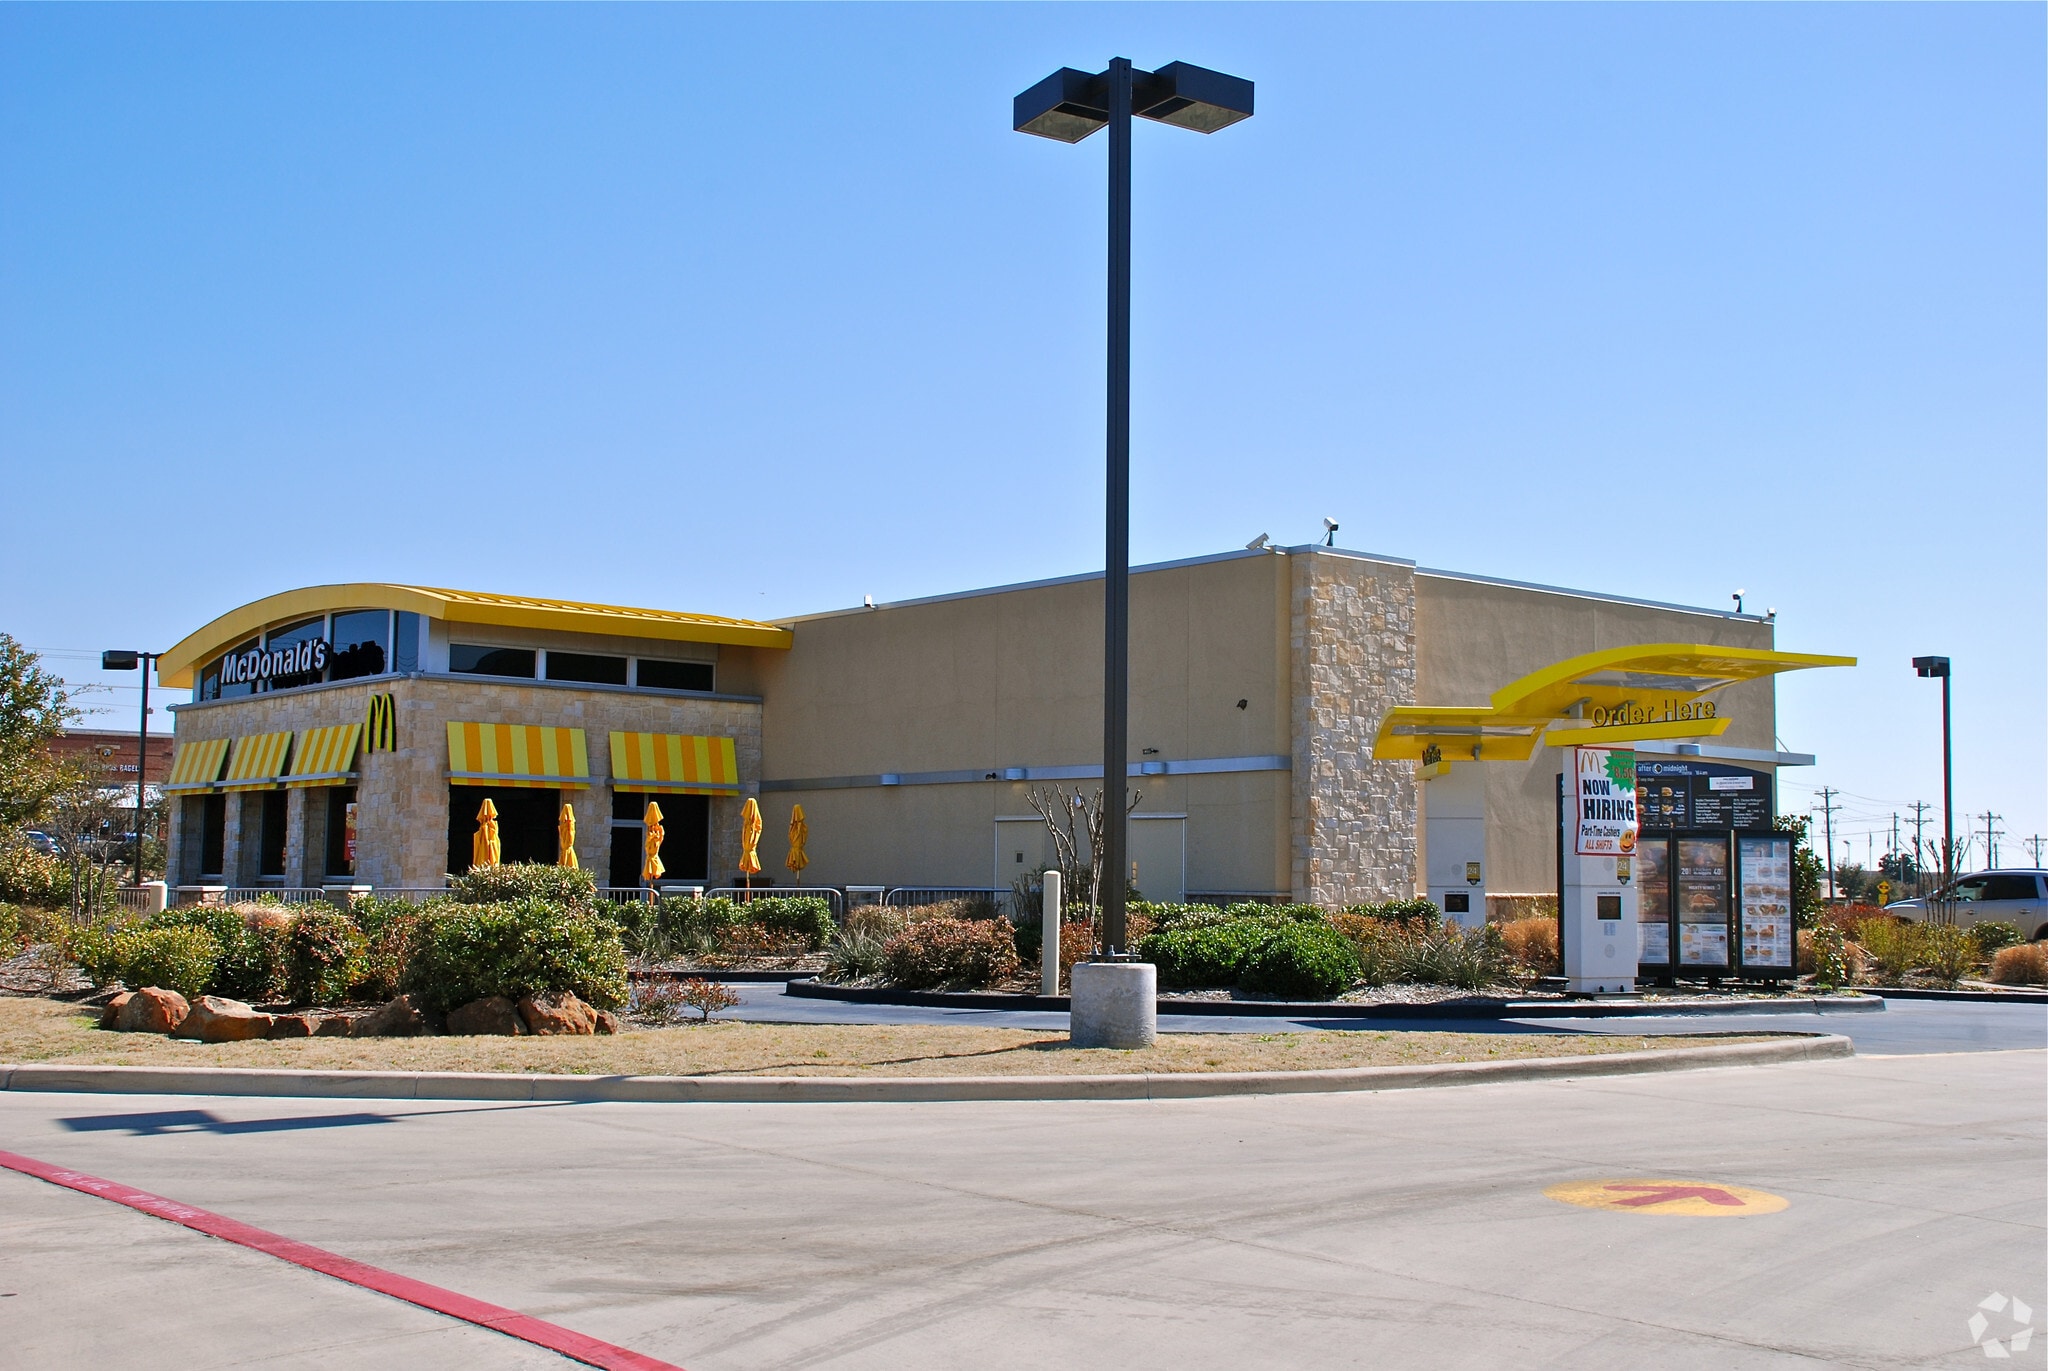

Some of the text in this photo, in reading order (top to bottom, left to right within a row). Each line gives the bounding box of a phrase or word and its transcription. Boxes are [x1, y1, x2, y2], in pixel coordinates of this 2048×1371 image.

[221, 638, 328, 684] McDonald's
[1591, 699, 1716, 727] Order Here
[1663, 764, 1688, 773] midnight
[1583, 779, 1611, 796] NOW
[1583, 799, 1636, 822] HIRING
[1581, 824, 1620, 837] Part-Time Cashiers
[1585, 840, 1613, 850] ALL SHIFTS
[1617, 861, 1627, 870] 24
